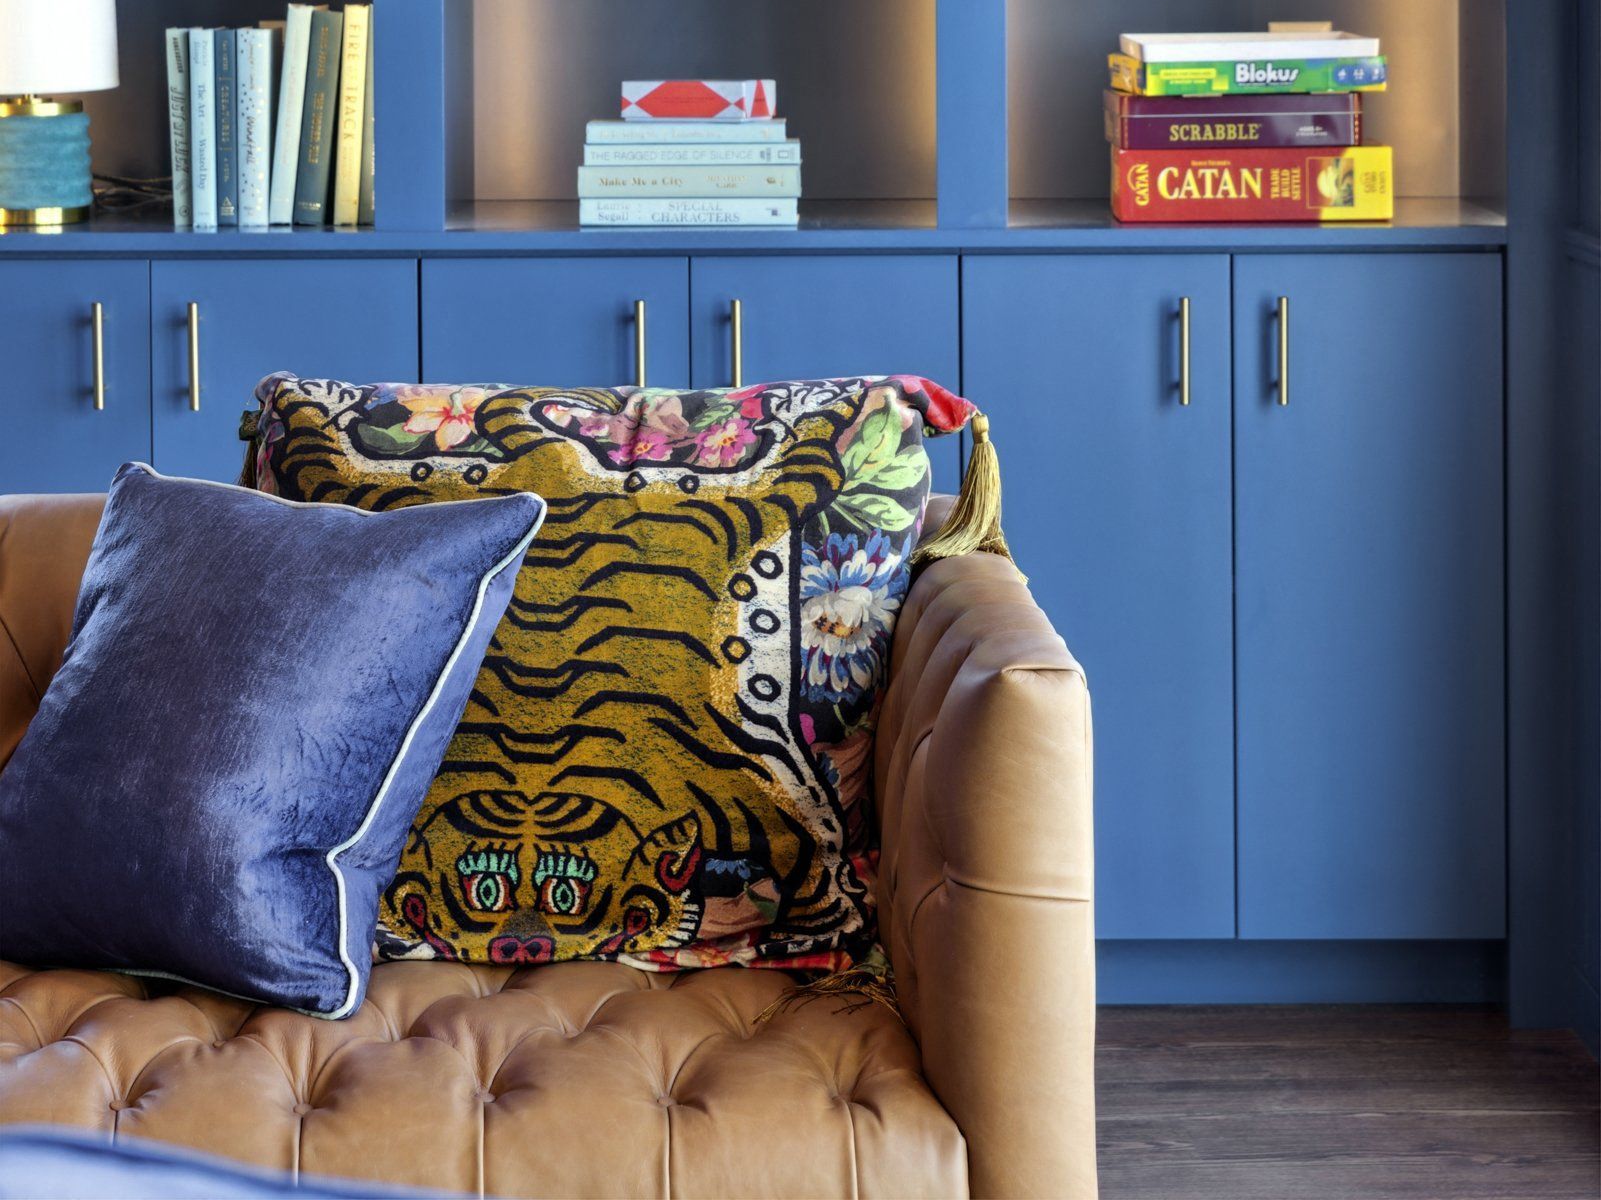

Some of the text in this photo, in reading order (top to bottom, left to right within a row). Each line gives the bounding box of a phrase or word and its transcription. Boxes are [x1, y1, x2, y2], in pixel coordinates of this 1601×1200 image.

[347, 24, 361, 60] FIRE
[1236, 62, 1299, 84] Blokus
[170, 86, 186, 122] JUST
[343, 86, 358, 140] TRACK
[198, 84, 207, 190] The Art Wasted Day
[242, 116, 256, 164] Windfall
[1169, 124, 1260, 142] SCRABBLE
[175, 140, 189, 174] LUCK
[591, 150, 753, 160] THE RAGGED EDGE OF SILENCE
[599, 177, 628, 186] Make
[631, 177, 648, 186] Me
[662, 176, 684, 188] City
[1134, 162, 1150, 206] CATAN
[1157, 166, 1263, 200] CATAN
[1270, 168, 1280, 199] TRADE
[1281, 169, 1290, 198] BUILD
[1291, 167, 1301, 200] SETTLE
[651, 212, 740, 222] CHARACTERS
[668, 202, 723, 212] SPECIAL
